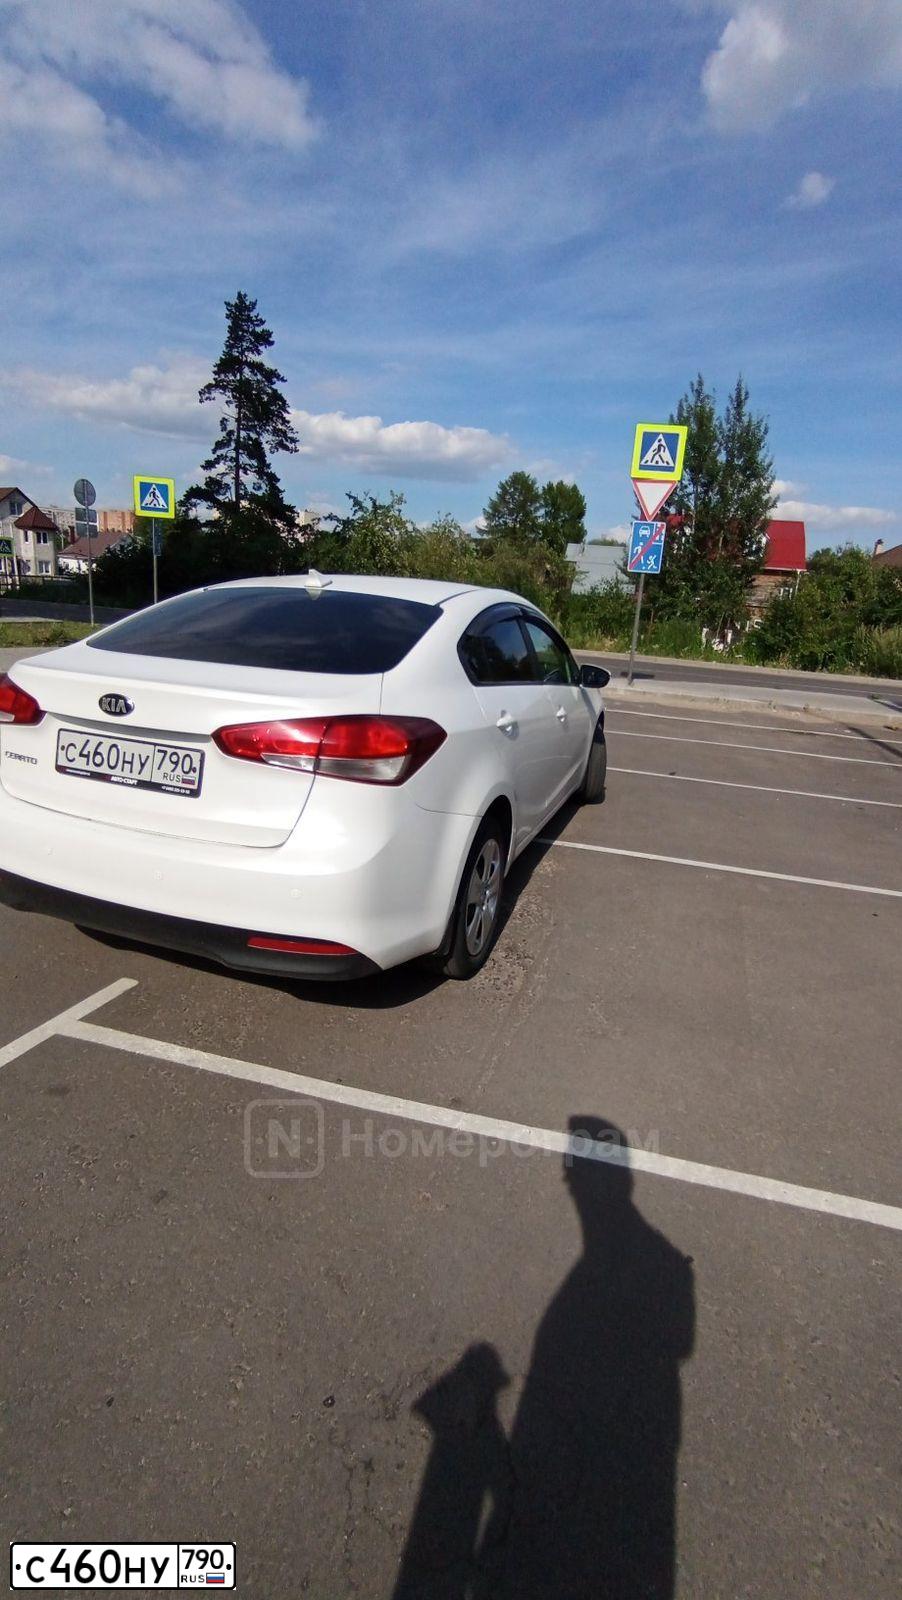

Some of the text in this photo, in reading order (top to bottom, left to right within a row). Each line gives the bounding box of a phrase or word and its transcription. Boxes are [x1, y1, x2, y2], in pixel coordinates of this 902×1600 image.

[101, 697, 127, 713] KIA
[157, 749, 193, 775] 790
[163, 772, 181, 783] RUS
